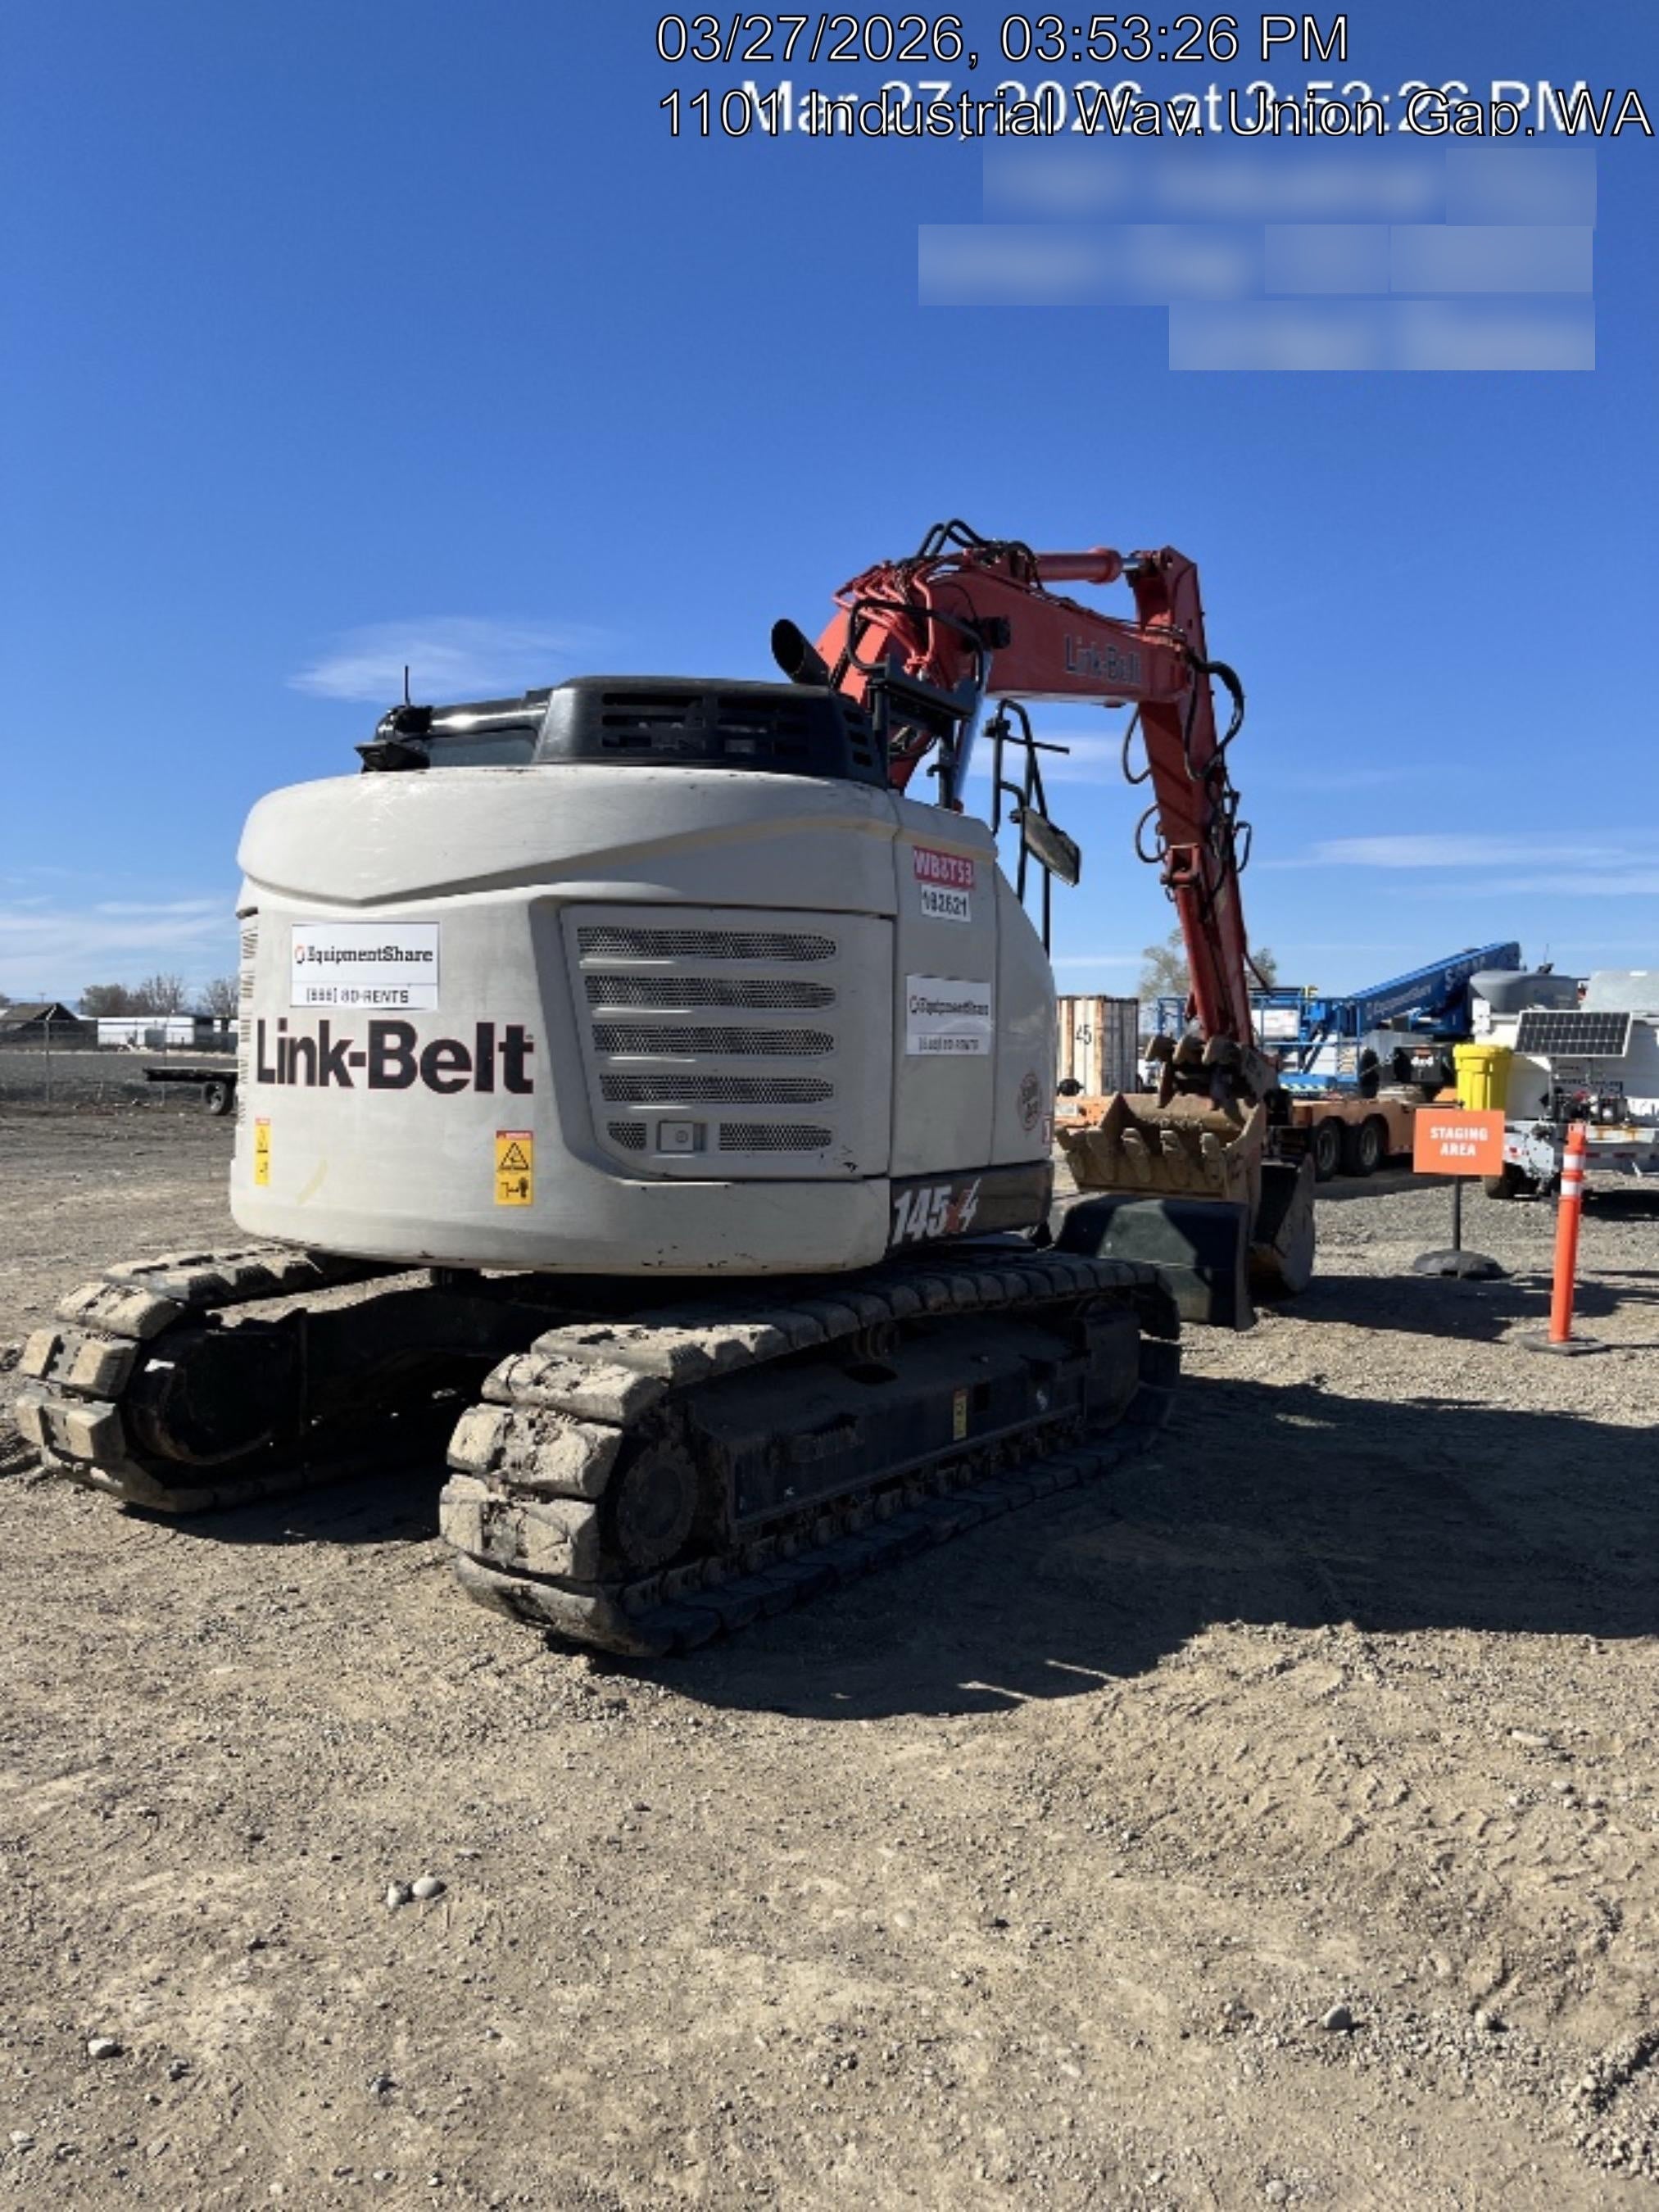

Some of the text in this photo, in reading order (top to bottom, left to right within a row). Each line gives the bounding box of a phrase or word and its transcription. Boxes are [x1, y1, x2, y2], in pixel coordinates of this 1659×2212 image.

[307, 945, 433, 965] EquipmentShare
[256, 1018, 534, 1095] Link-Belt
[1430, 1126, 1489, 1142] STAGING
[1439, 1142, 1476, 1157] AREA
